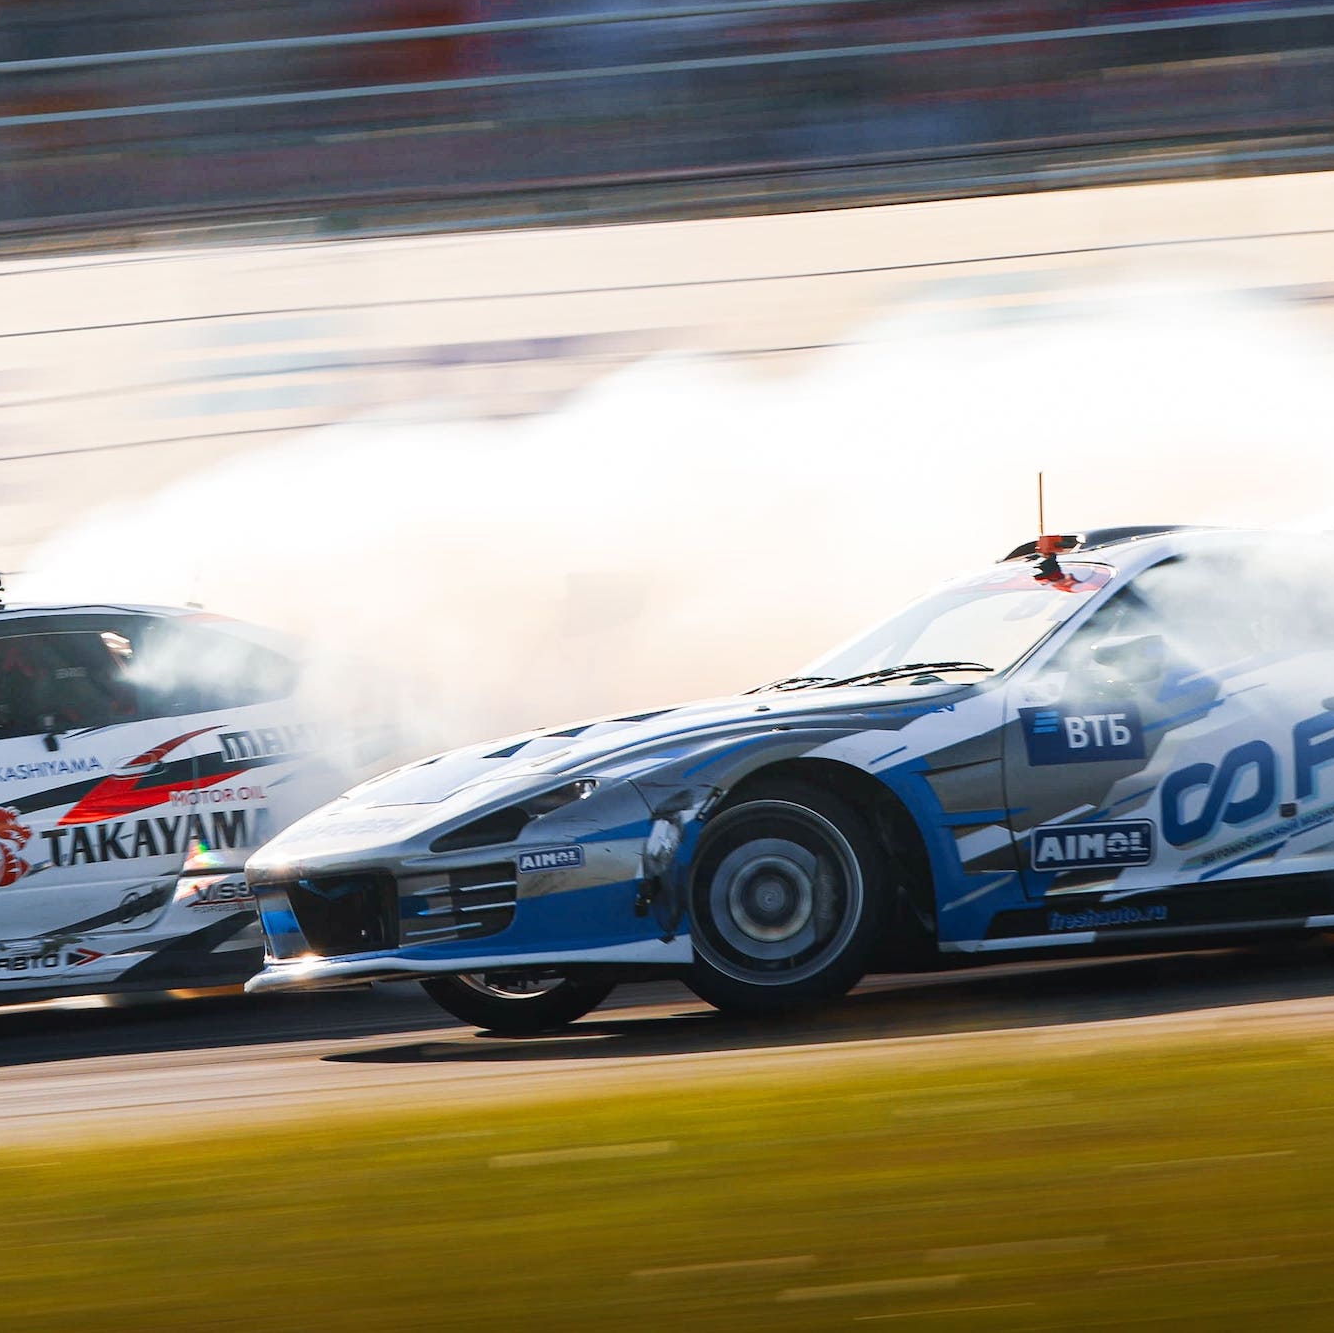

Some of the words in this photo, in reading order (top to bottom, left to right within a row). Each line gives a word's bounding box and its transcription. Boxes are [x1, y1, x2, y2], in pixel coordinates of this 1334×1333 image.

[1064, 713, 1132, 749] ВТБ
[169, 788, 234, 808] MOTOR
[236, 786, 267, 803] OIL
[522, 850, 579, 869] AIMOL
[1036, 831, 1150, 863] AIMOL
[1048, 905, 1167, 931] freshauto.ru
